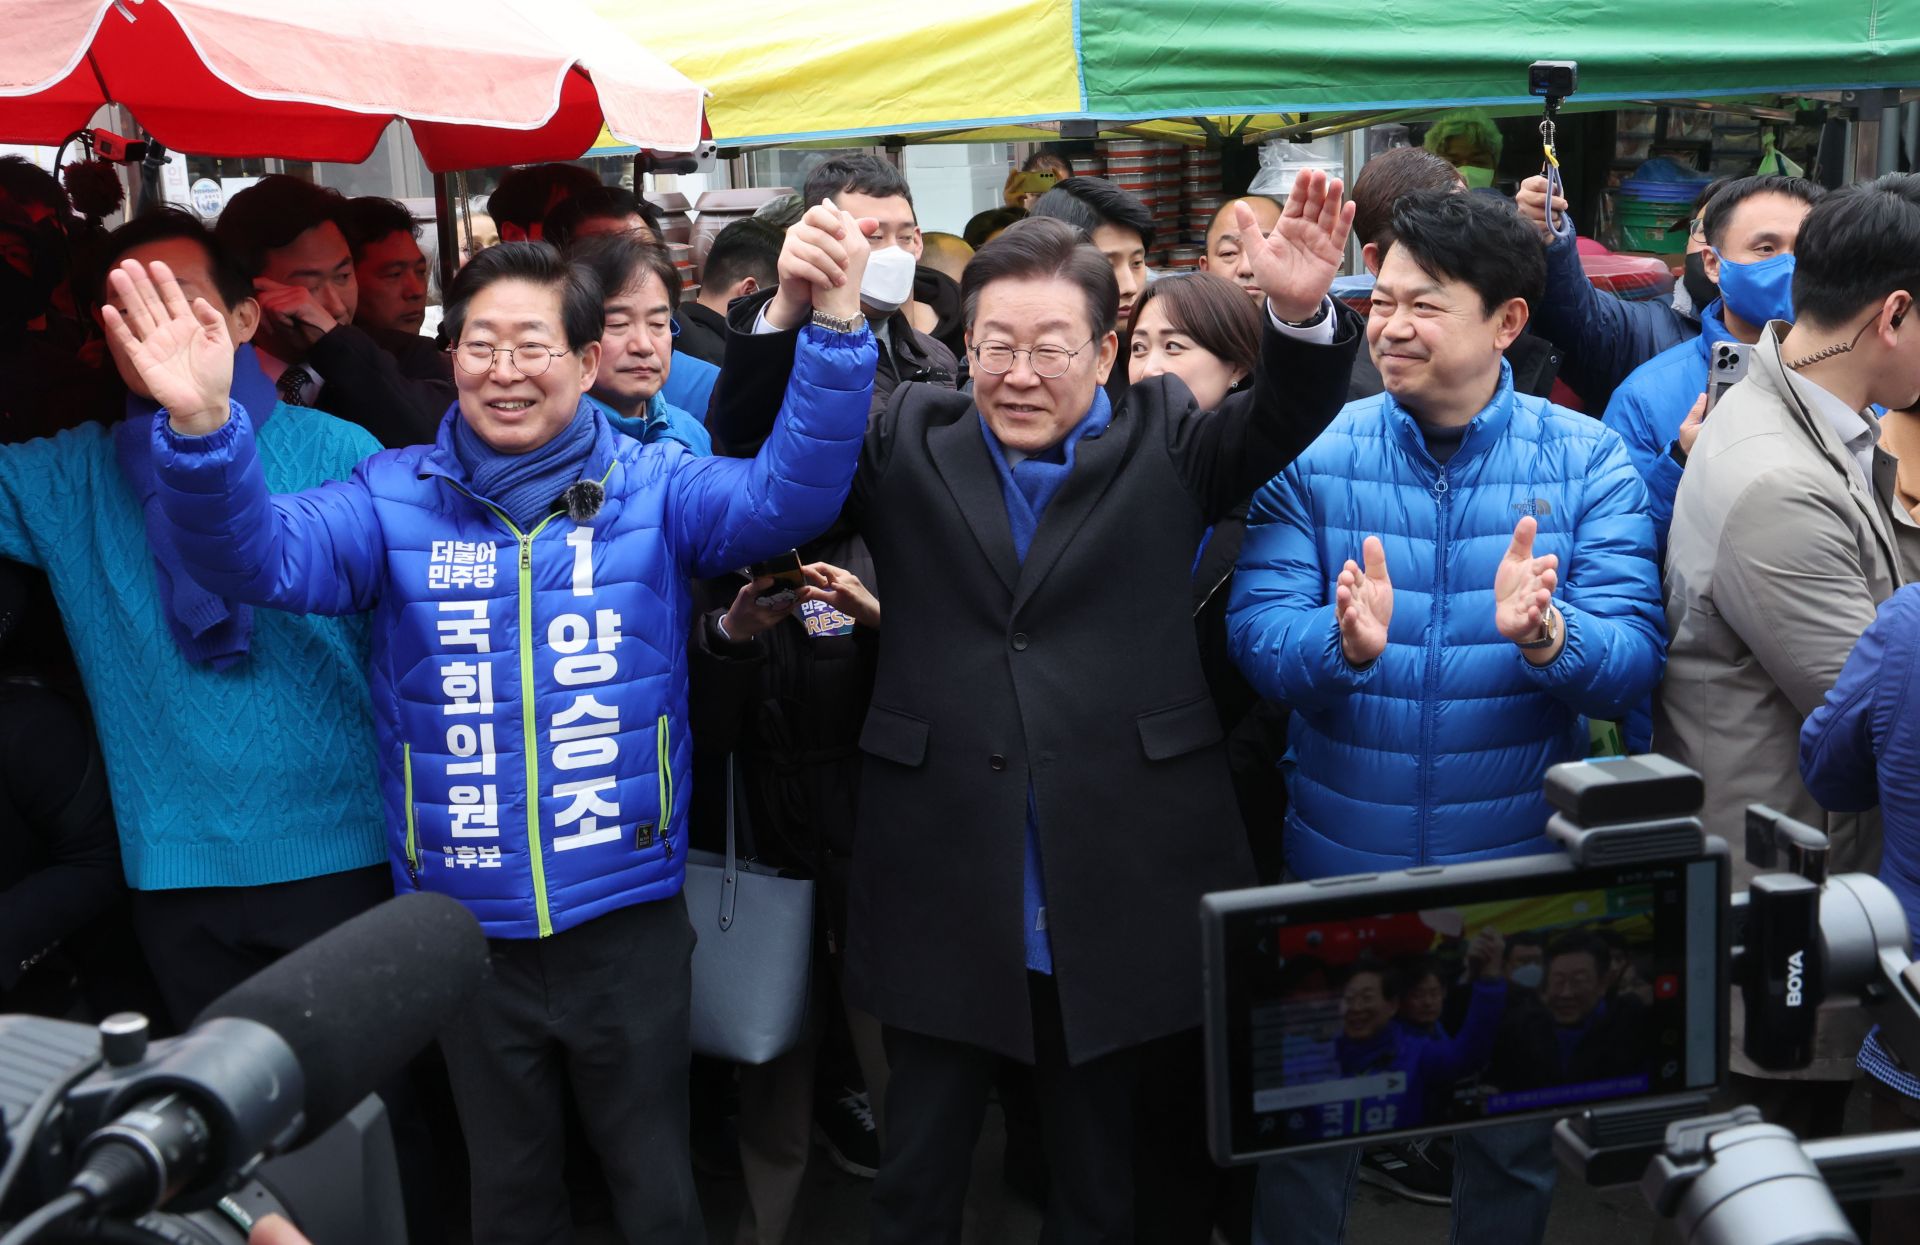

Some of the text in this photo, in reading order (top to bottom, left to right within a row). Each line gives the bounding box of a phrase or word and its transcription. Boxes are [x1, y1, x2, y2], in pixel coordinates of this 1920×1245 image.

[431, 541, 497, 564] 더불어
[429, 564, 497, 589] 민주당
[804, 610, 856, 636] RESS
[548, 526, 623, 853] 1 양승조
[437, 600, 499, 838] 국회의원
[1786, 950, 1804, 1007] BOYA
